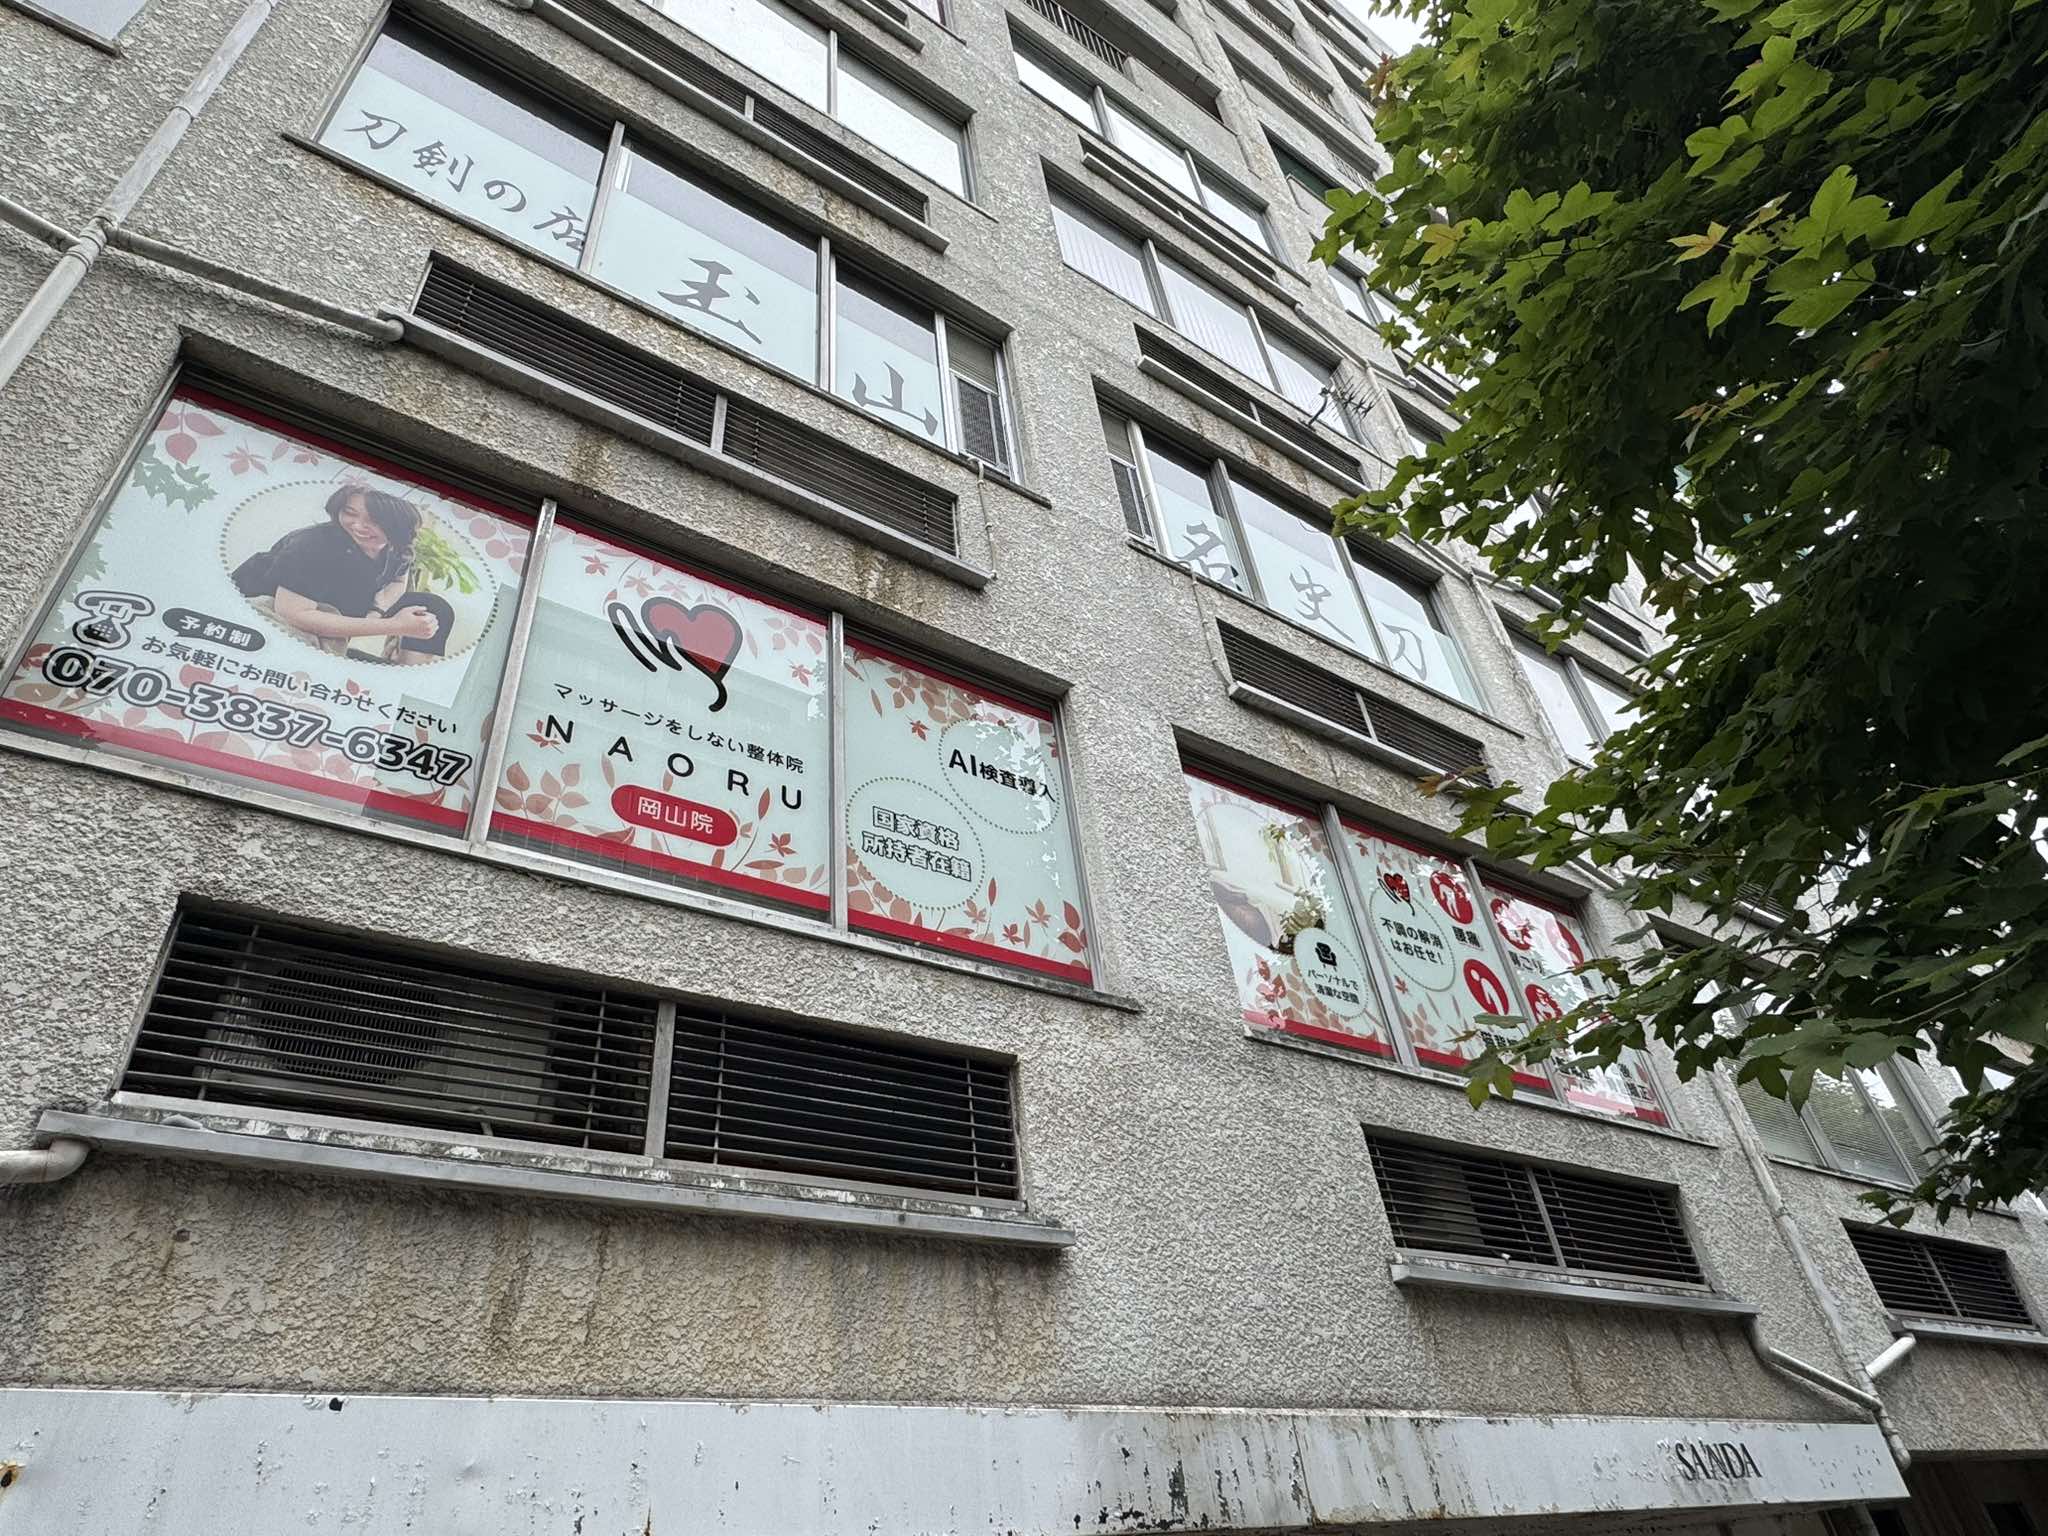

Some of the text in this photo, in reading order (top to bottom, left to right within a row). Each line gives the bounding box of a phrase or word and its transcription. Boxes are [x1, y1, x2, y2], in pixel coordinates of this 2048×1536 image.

[344, 110, 586, 250] 刀剣の店
[179, 614, 252, 646] 予約制
[142, 635, 457, 735] お気軽にお問い合わせください
[43, 646, 472, 786] 070-3837-6347
[553, 683, 804, 774] マッサージをしない整体院
[545, 715, 802, 809] NAORU
[949, 749, 1055, 802] AI検査導入
[638, 796, 713, 834] 岡山院
[872, 806, 960, 851] 国家資格
[862, 831, 973, 882] 所持者在籍
[1674, 1440, 1763, 1481] SANDA
